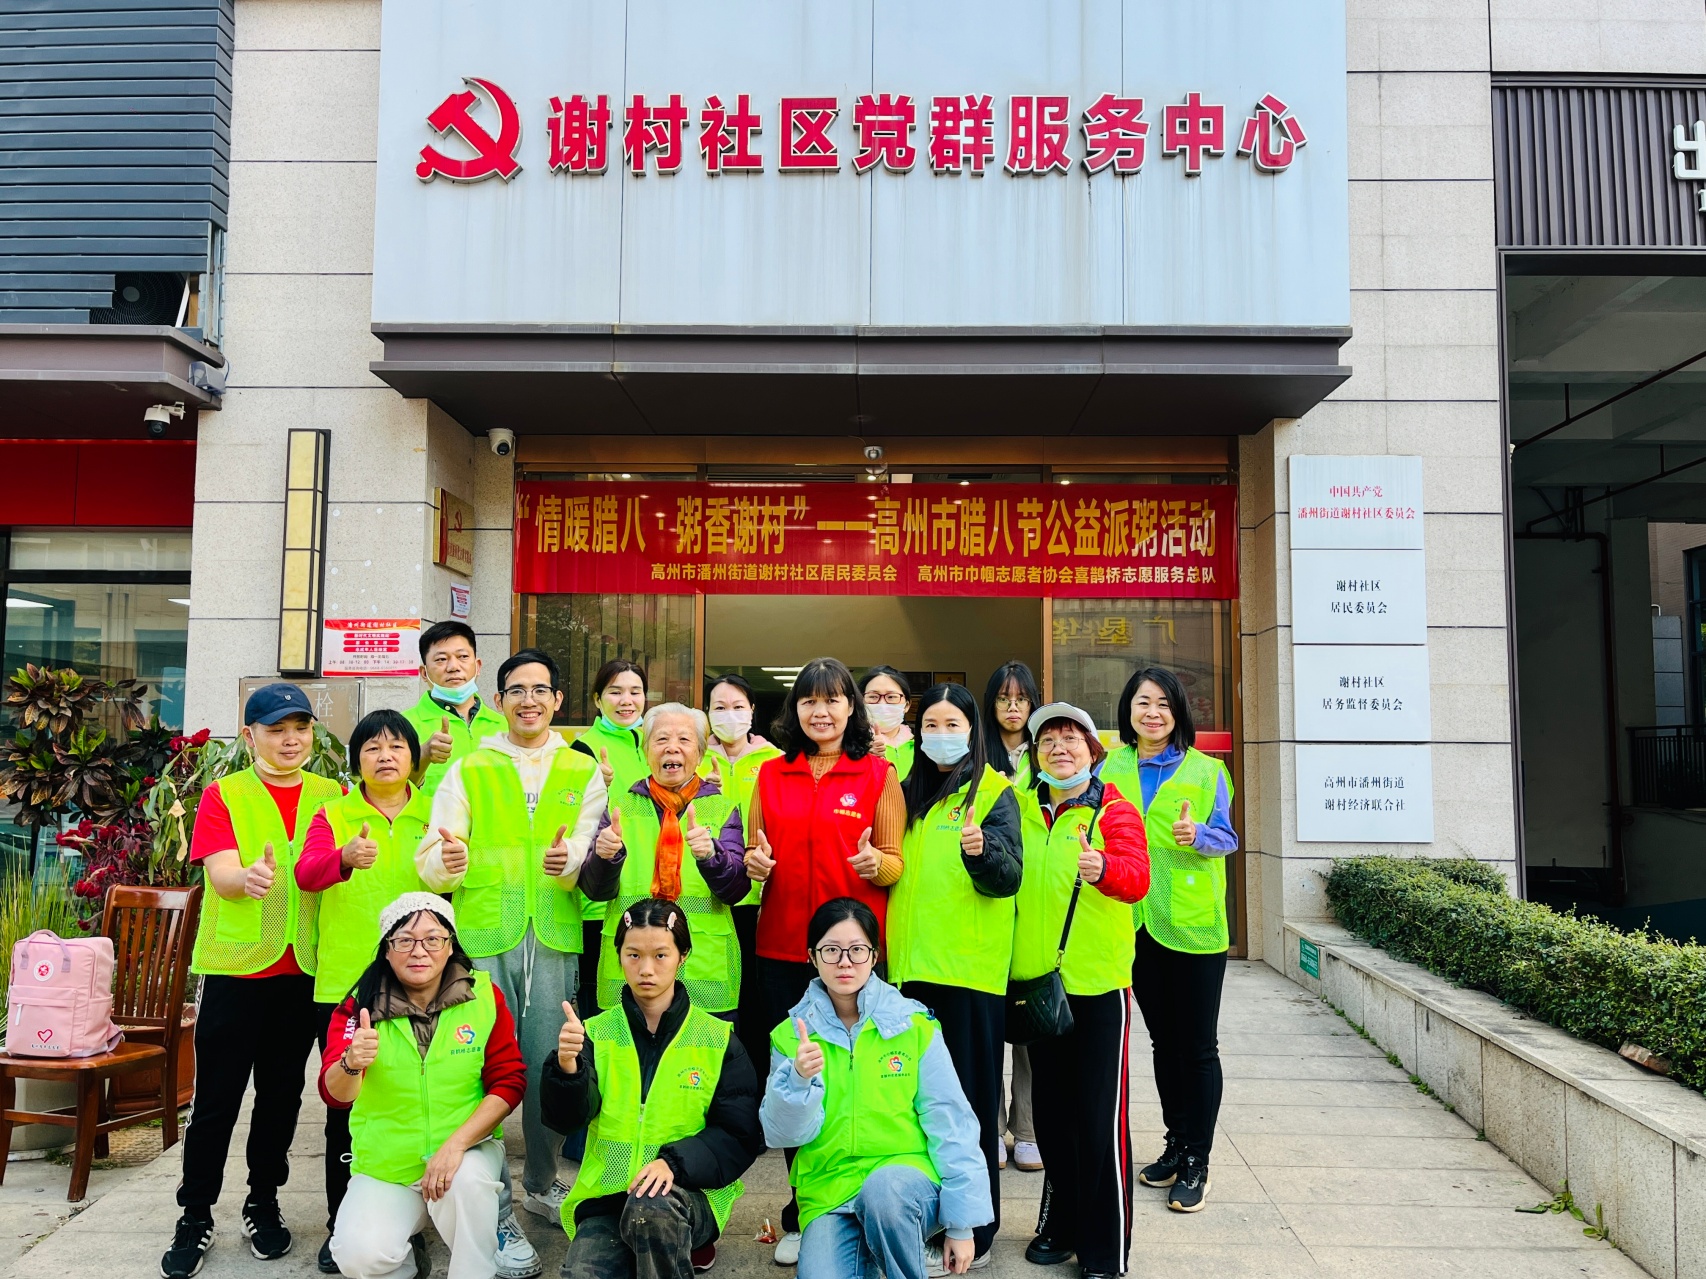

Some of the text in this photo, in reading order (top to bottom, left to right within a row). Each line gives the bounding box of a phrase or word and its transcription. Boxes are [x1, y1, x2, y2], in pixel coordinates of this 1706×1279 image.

[546, 92, 1307, 176] 谢村社区党群服务中心
[1329, 485, 1384, 498] 中国共产党
[1297, 507, 1416, 520] 潘州街道谢村社区委员会
[650, 562, 1217, 585] 高州市潘州街道谢村社区居民委员会 高州市巾帼志愿者协会喜鹊桥志愿服务总队
[1336, 579, 1382, 592] 谢村社区
[1330, 601, 1388, 615] 居民委员会
[1339, 676, 1385, 689] 谢村社区
[1322, 698, 1403, 711] 居务监督委员会
[1324, 776, 1405, 789] 高州市潘州街道
[1324, 799, 1406, 811] 谢村经济联合社
